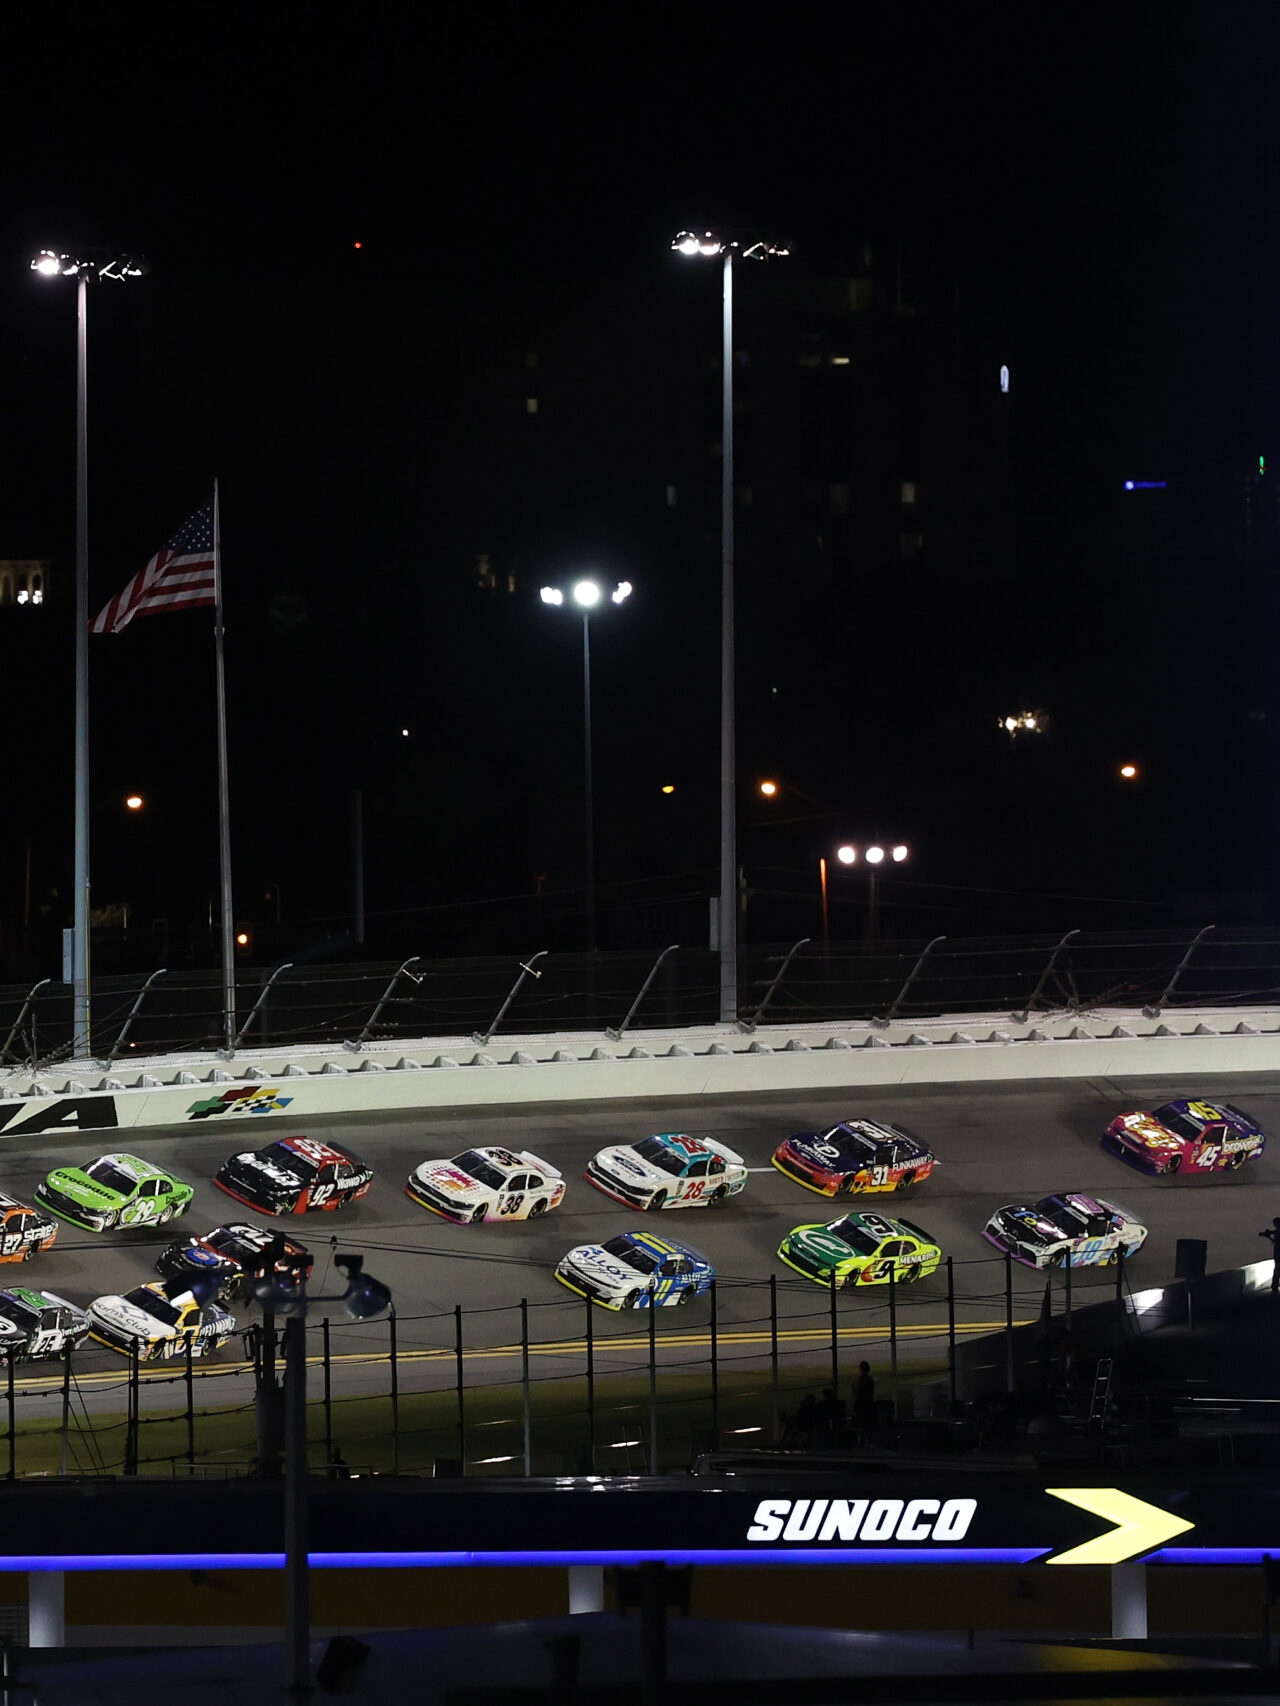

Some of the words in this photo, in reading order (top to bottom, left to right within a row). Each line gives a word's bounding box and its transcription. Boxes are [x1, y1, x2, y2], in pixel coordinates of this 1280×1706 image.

[1187, 1101, 1223, 1121] 45
[293, 1139, 333, 1160] 92
[668, 1134, 709, 1154] 28
[485, 1148, 524, 1167] 38
[1197, 1145, 1222, 1167] 45
[870, 1165, 889, 1186] 31
[55, 1171, 115, 1202] Crocodile
[308, 1184, 336, 1207] 92
[682, 1181, 706, 1200] 28
[131, 1199, 156, 1224] 29
[501, 1194, 524, 1216] 38
[24, 1225, 53, 1242] state
[860, 1213, 898, 1237] 9
[2, 1233, 23, 1255] 27
[576, 1249, 635, 1281] ALLOY
[899, 1252, 934, 1265] MENARDS
[874, 1259, 896, 1280] 9
[746, 1499, 978, 1541] SUNOCO
